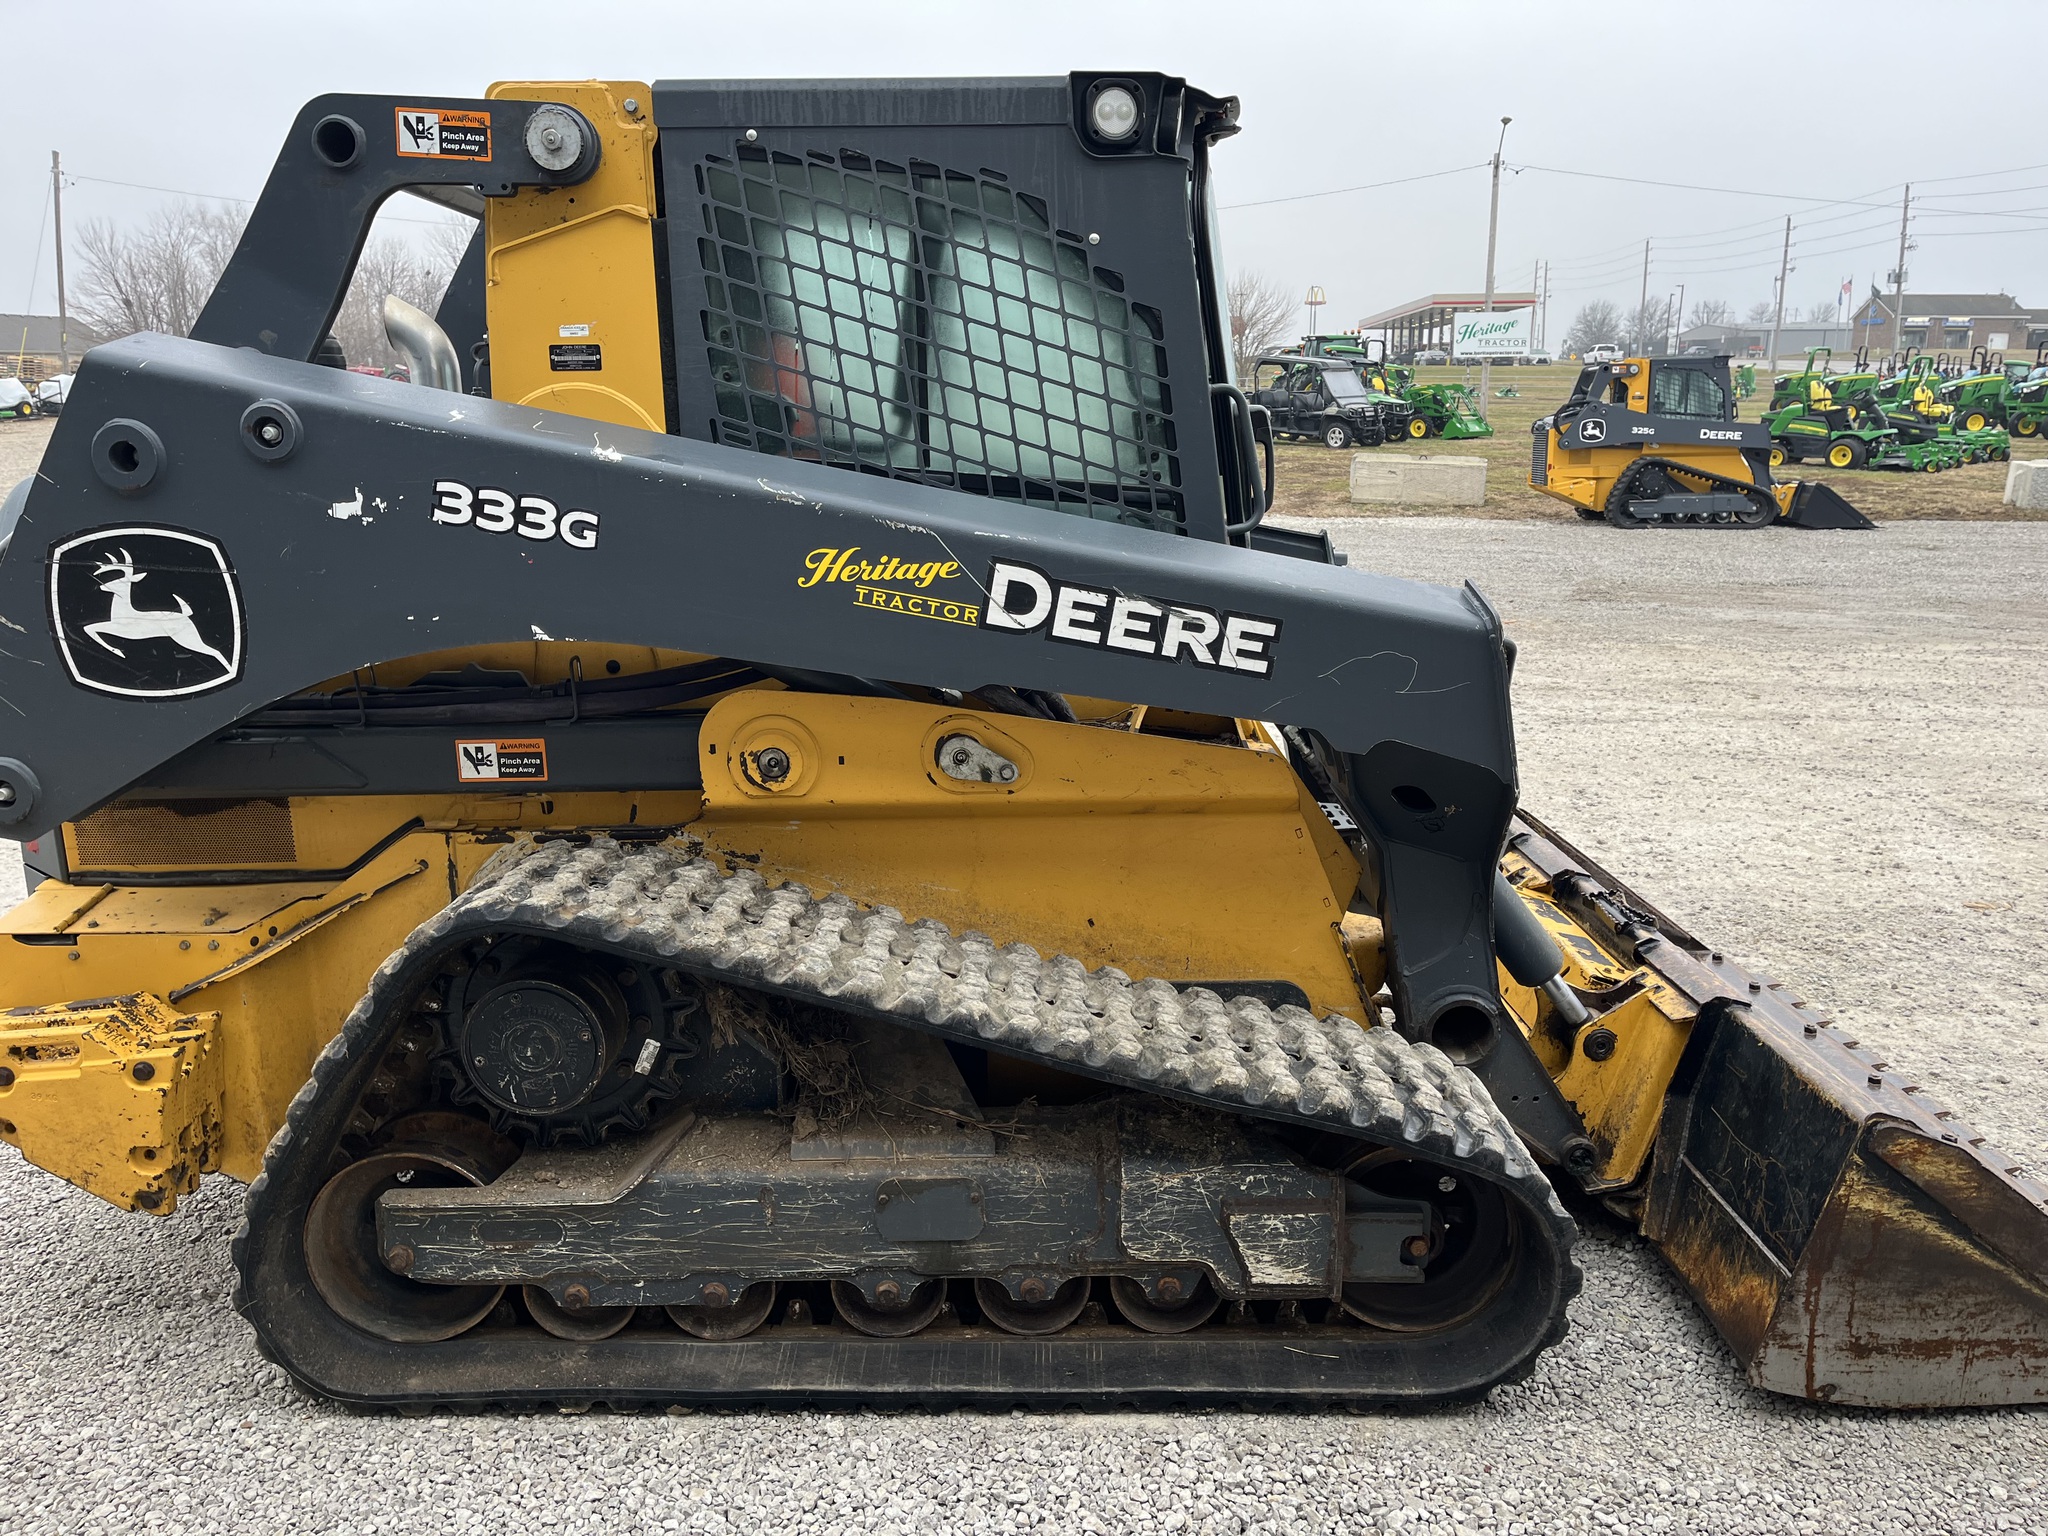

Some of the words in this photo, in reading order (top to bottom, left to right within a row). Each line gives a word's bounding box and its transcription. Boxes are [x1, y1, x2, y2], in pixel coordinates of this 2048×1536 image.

[449, 114, 486, 124] WARNING
[442, 131, 465, 141] Pinch
[466, 133, 485, 142] Area
[442, 142, 460, 150] Keep
[461, 143, 479, 152] Away
[1456, 319, 1519, 344] Heritage
[1631, 426, 1655, 435] 325G
[1699, 428, 1743, 441] DEERE
[433, 480, 599, 549] 333G
[797, 546, 961, 589] Heritage
[857, 589, 978, 622] TRACTOR
[985, 562, 1277, 673] DEERE
[506, 742, 541, 750] WARNING
[500, 757, 522, 765] Pinch
[523, 757, 541, 765] Area
[501, 766, 518, 774] Keep
[518, 766, 536, 774] Away
